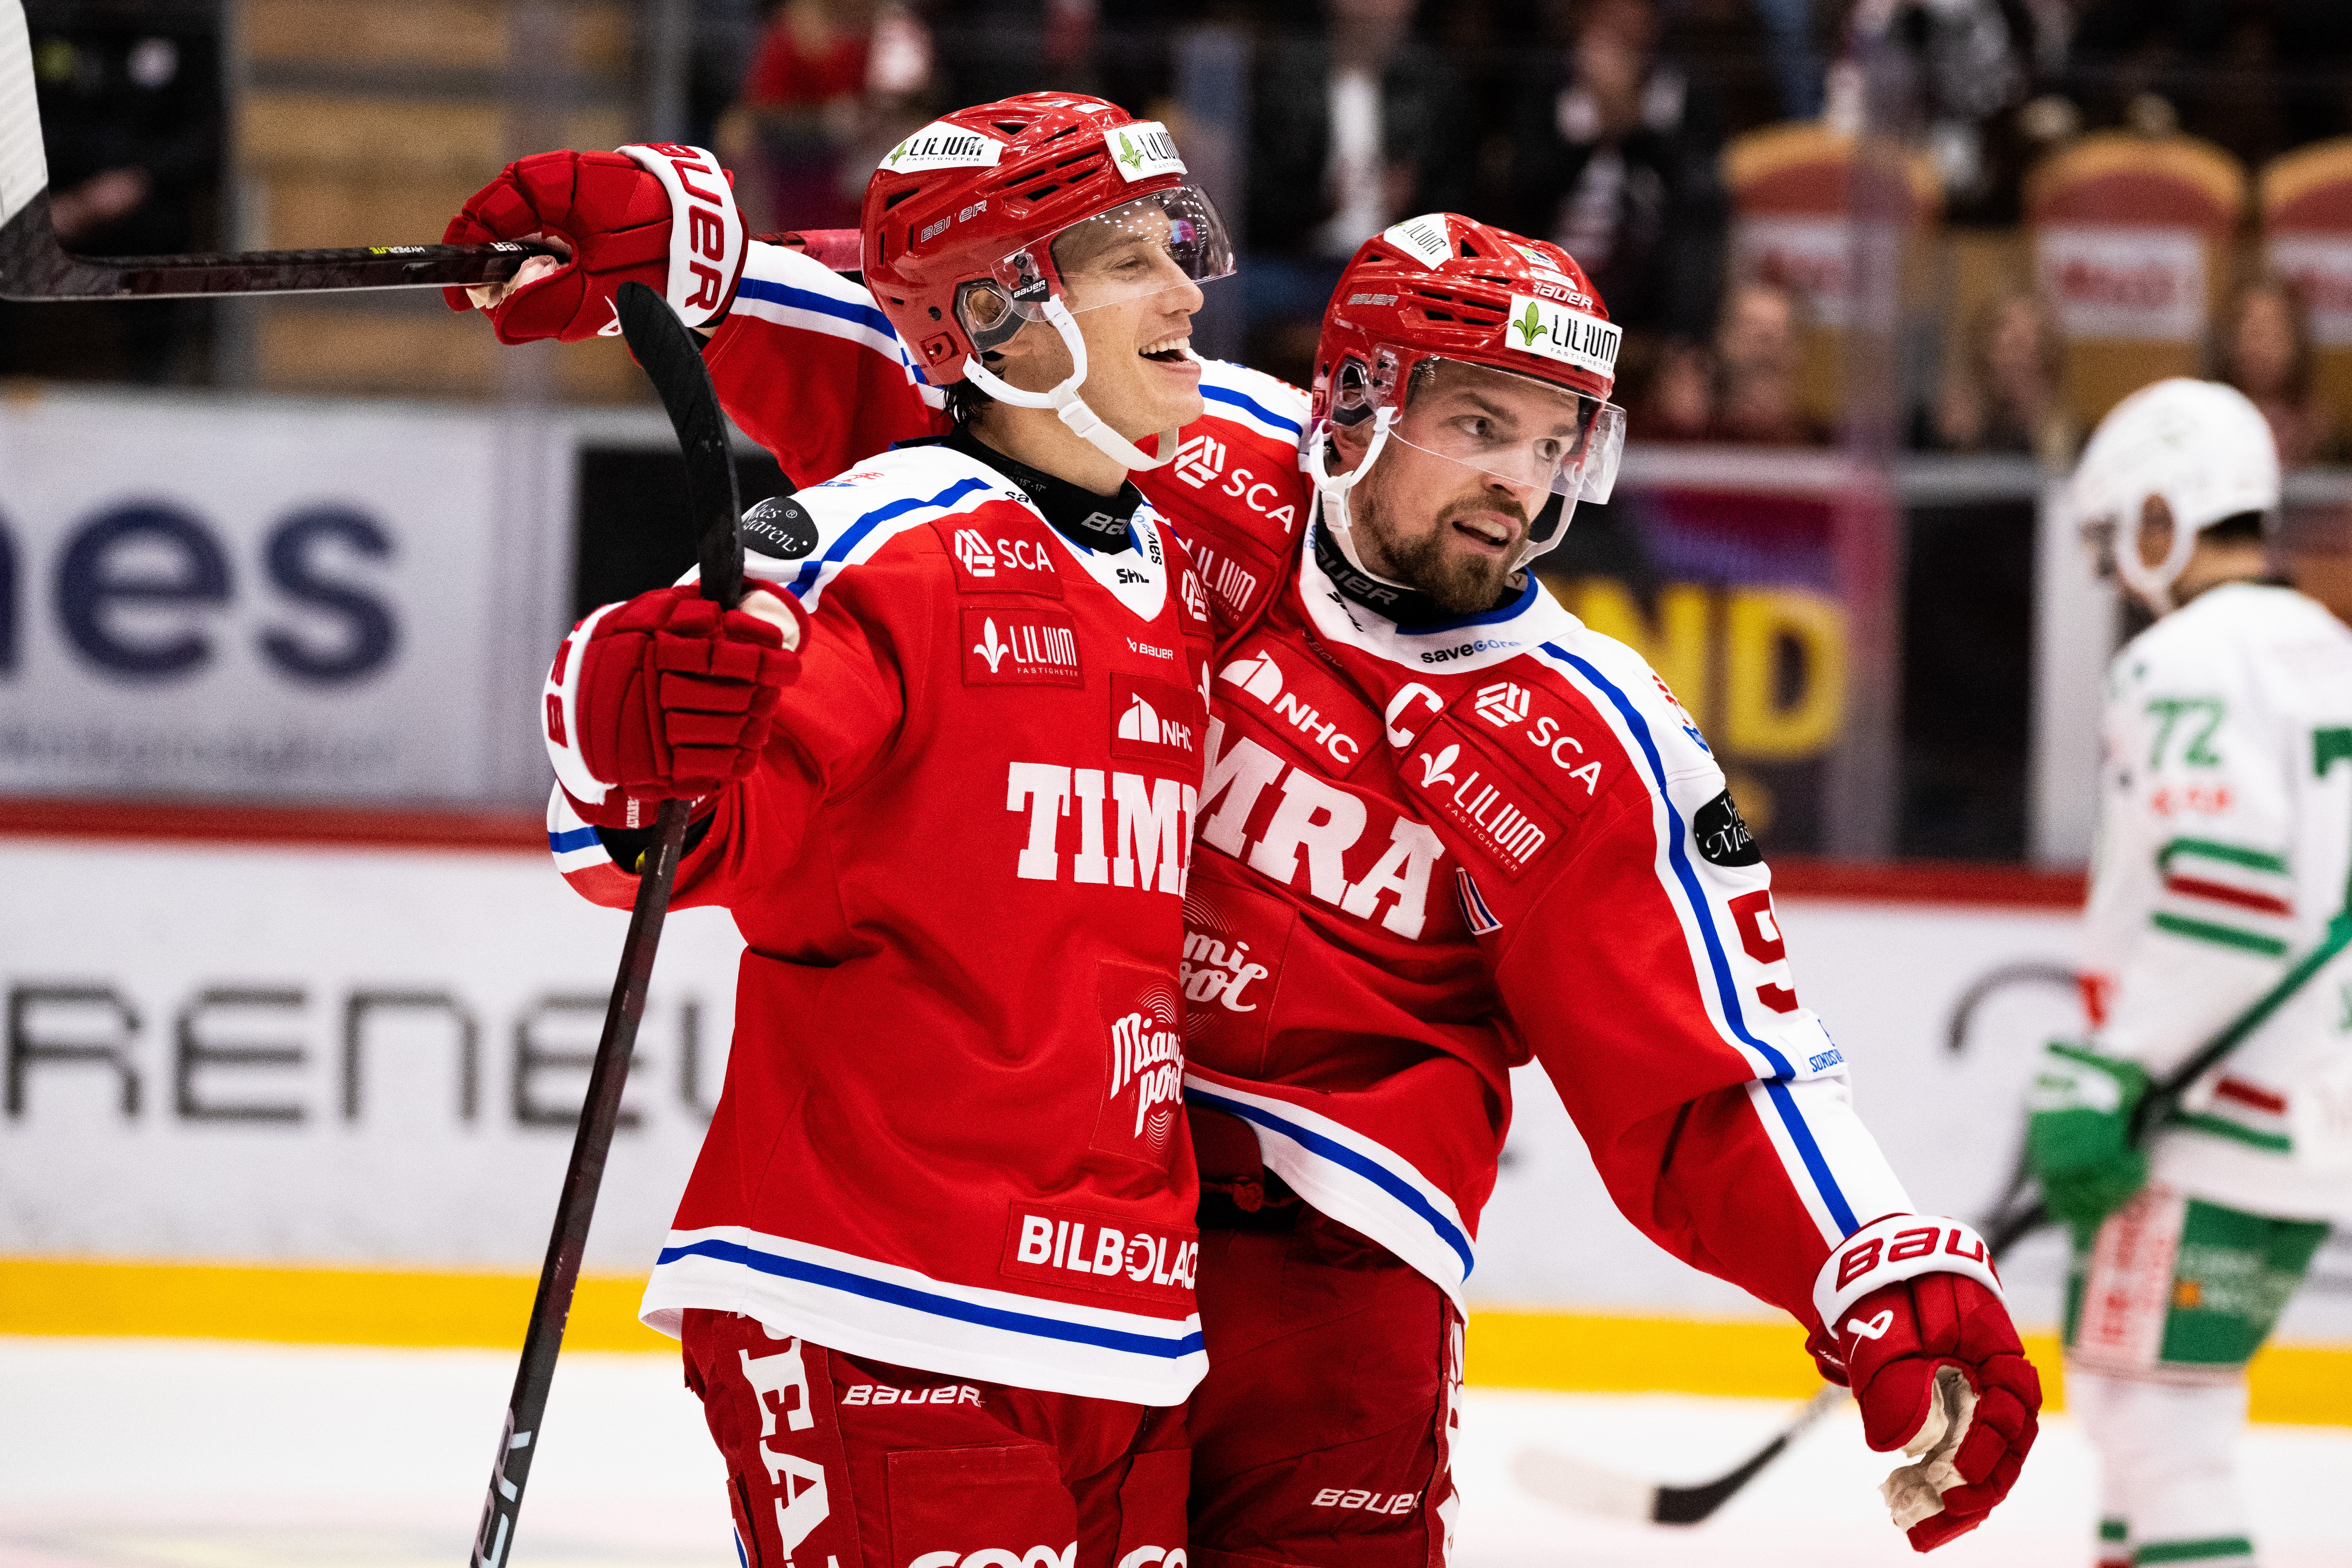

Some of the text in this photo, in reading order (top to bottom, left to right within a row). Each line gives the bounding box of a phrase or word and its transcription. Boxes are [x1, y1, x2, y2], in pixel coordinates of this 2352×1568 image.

[909, 137, 984, 156] LILIUM
[643, 142, 724, 310] AUER
[1552, 315, 1617, 363] LILIUM
[1223, 469, 1294, 534] SCA
[997, 539, 1055, 573] SCA
[1116, 568, 1149, 584] SHL
[0, 496, 402, 686] es
[1010, 626, 1076, 666] LILIUM
[1018, 668, 1078, 676] FASTIGHETER
[1552, 574, 1844, 755] ND
[1162, 719, 1192, 751] NHC
[1273, 692, 1358, 763] NHC
[1385, 682, 1443, 748] C
[2147, 697, 2227, 771] 72
[1527, 716, 1602, 795] SCA
[1445, 803, 1517, 872] FASTIGHETER
[1454, 771, 1545, 864] LILIUM
[1728, 889, 1799, 1014] 9
[1110, 1013, 1181, 1100] Miami
